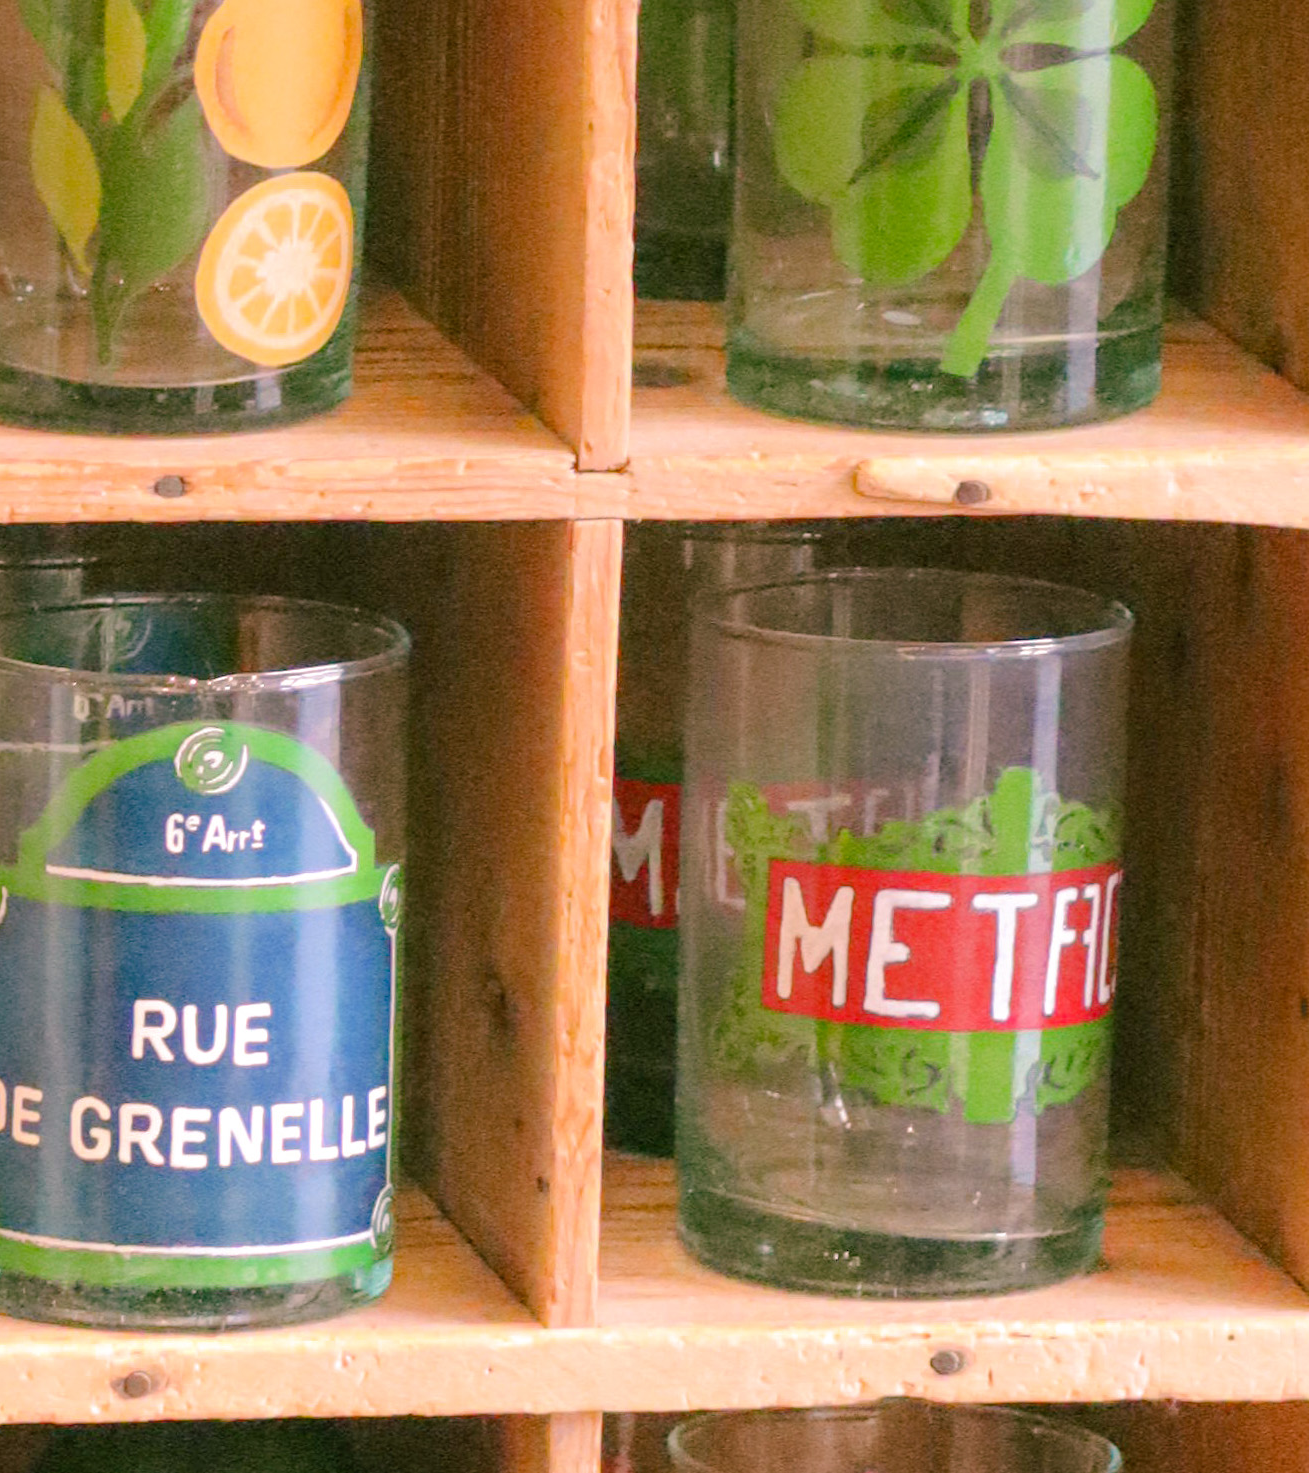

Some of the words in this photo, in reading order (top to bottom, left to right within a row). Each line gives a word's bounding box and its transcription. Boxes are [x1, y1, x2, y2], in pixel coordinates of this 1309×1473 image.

[165, 812, 202, 855] 6e
[201, 814, 267, 854] Arrt
[131, 998, 273, 1068] RUE
[68, 1084, 390, 1172] GRENELLE
